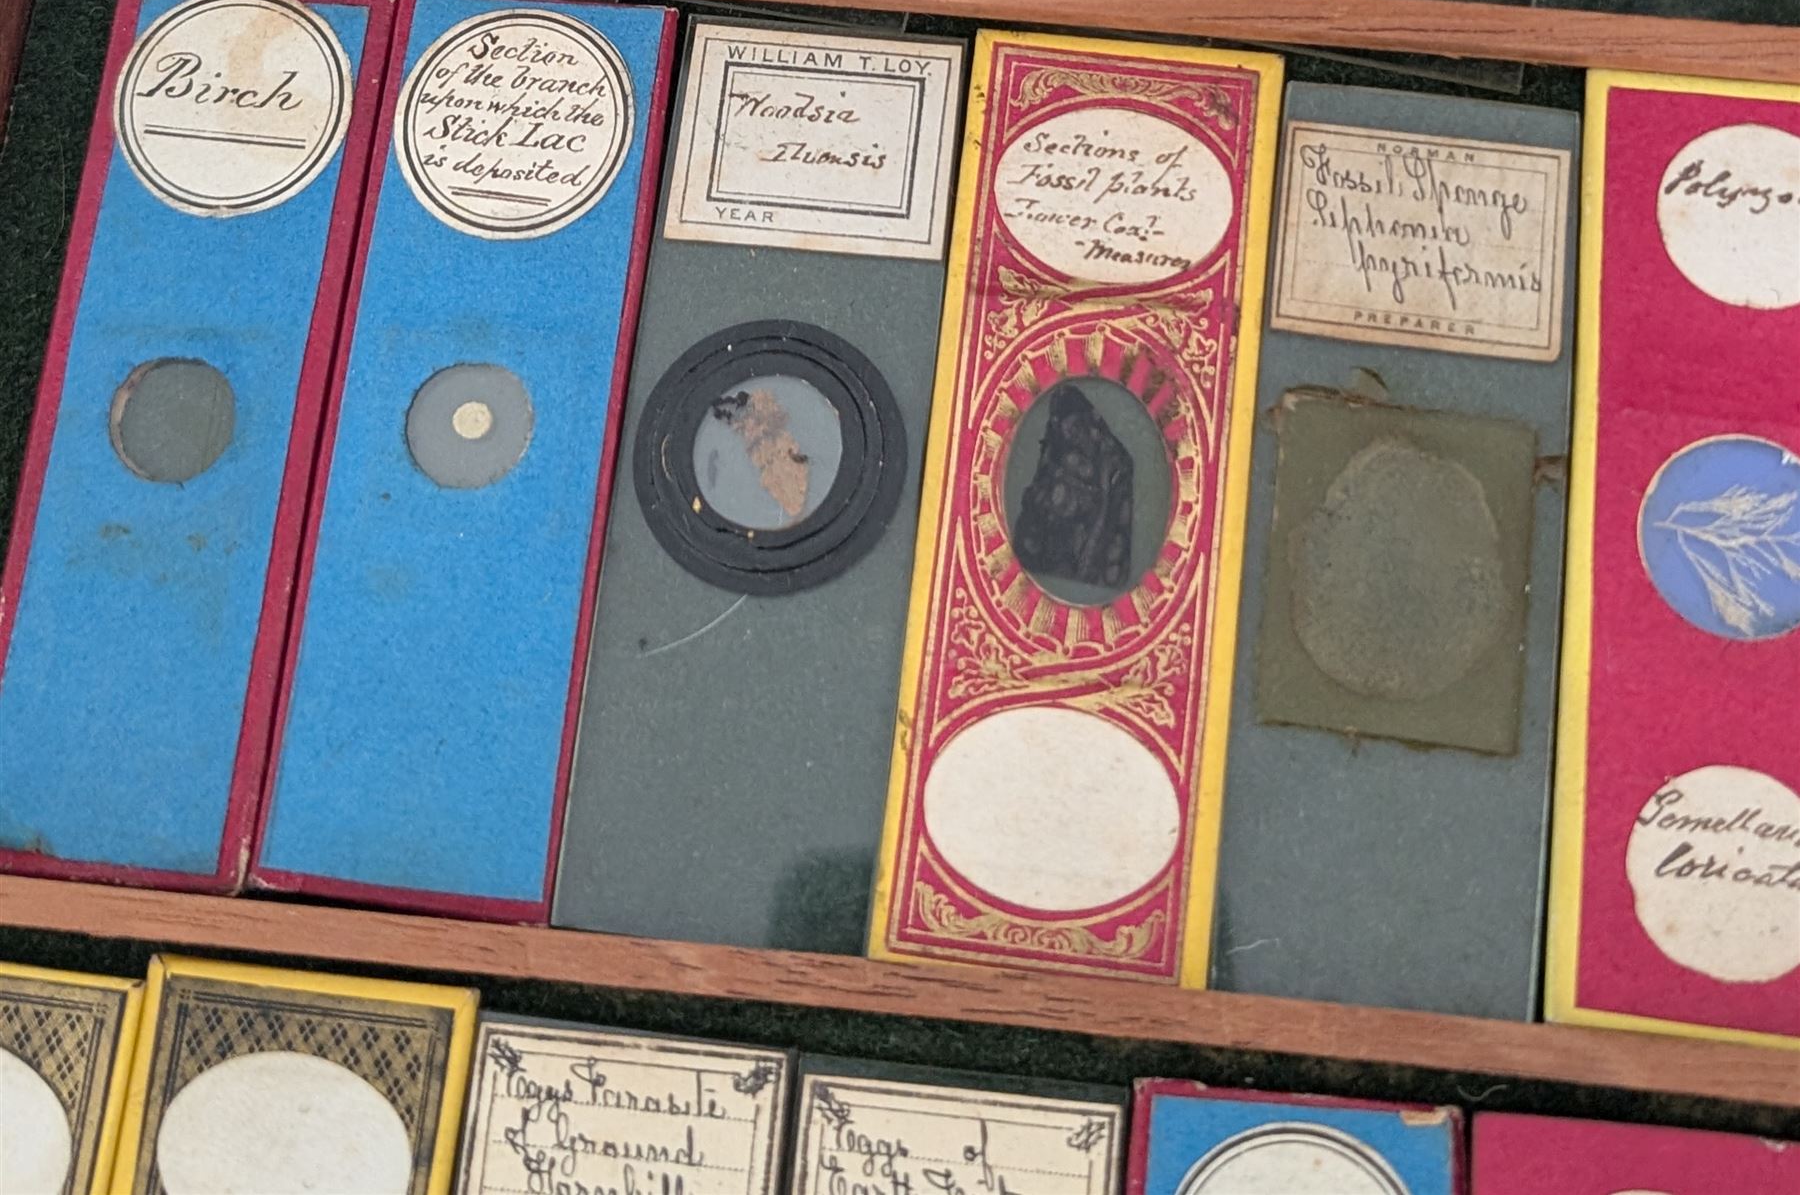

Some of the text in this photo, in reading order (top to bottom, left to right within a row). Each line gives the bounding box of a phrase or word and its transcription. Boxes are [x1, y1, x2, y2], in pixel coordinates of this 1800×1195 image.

[467, 33, 579, 66] Section
[728, 45, 842, 69] WILLIAM
[136, 51, 303, 111] Birch
[436, 62, 608, 97] of the branch
[420, 88, 605, 127] upon which the
[424, 114, 587, 152] Stick Lac
[424, 144, 591, 187] is deposited
[1024, 129, 1188, 186] Sections of
[1377, 142, 1475, 163] NORMAN
[715, 206, 774, 223] YEAR
[1353, 311, 1475, 335] PREPARER
